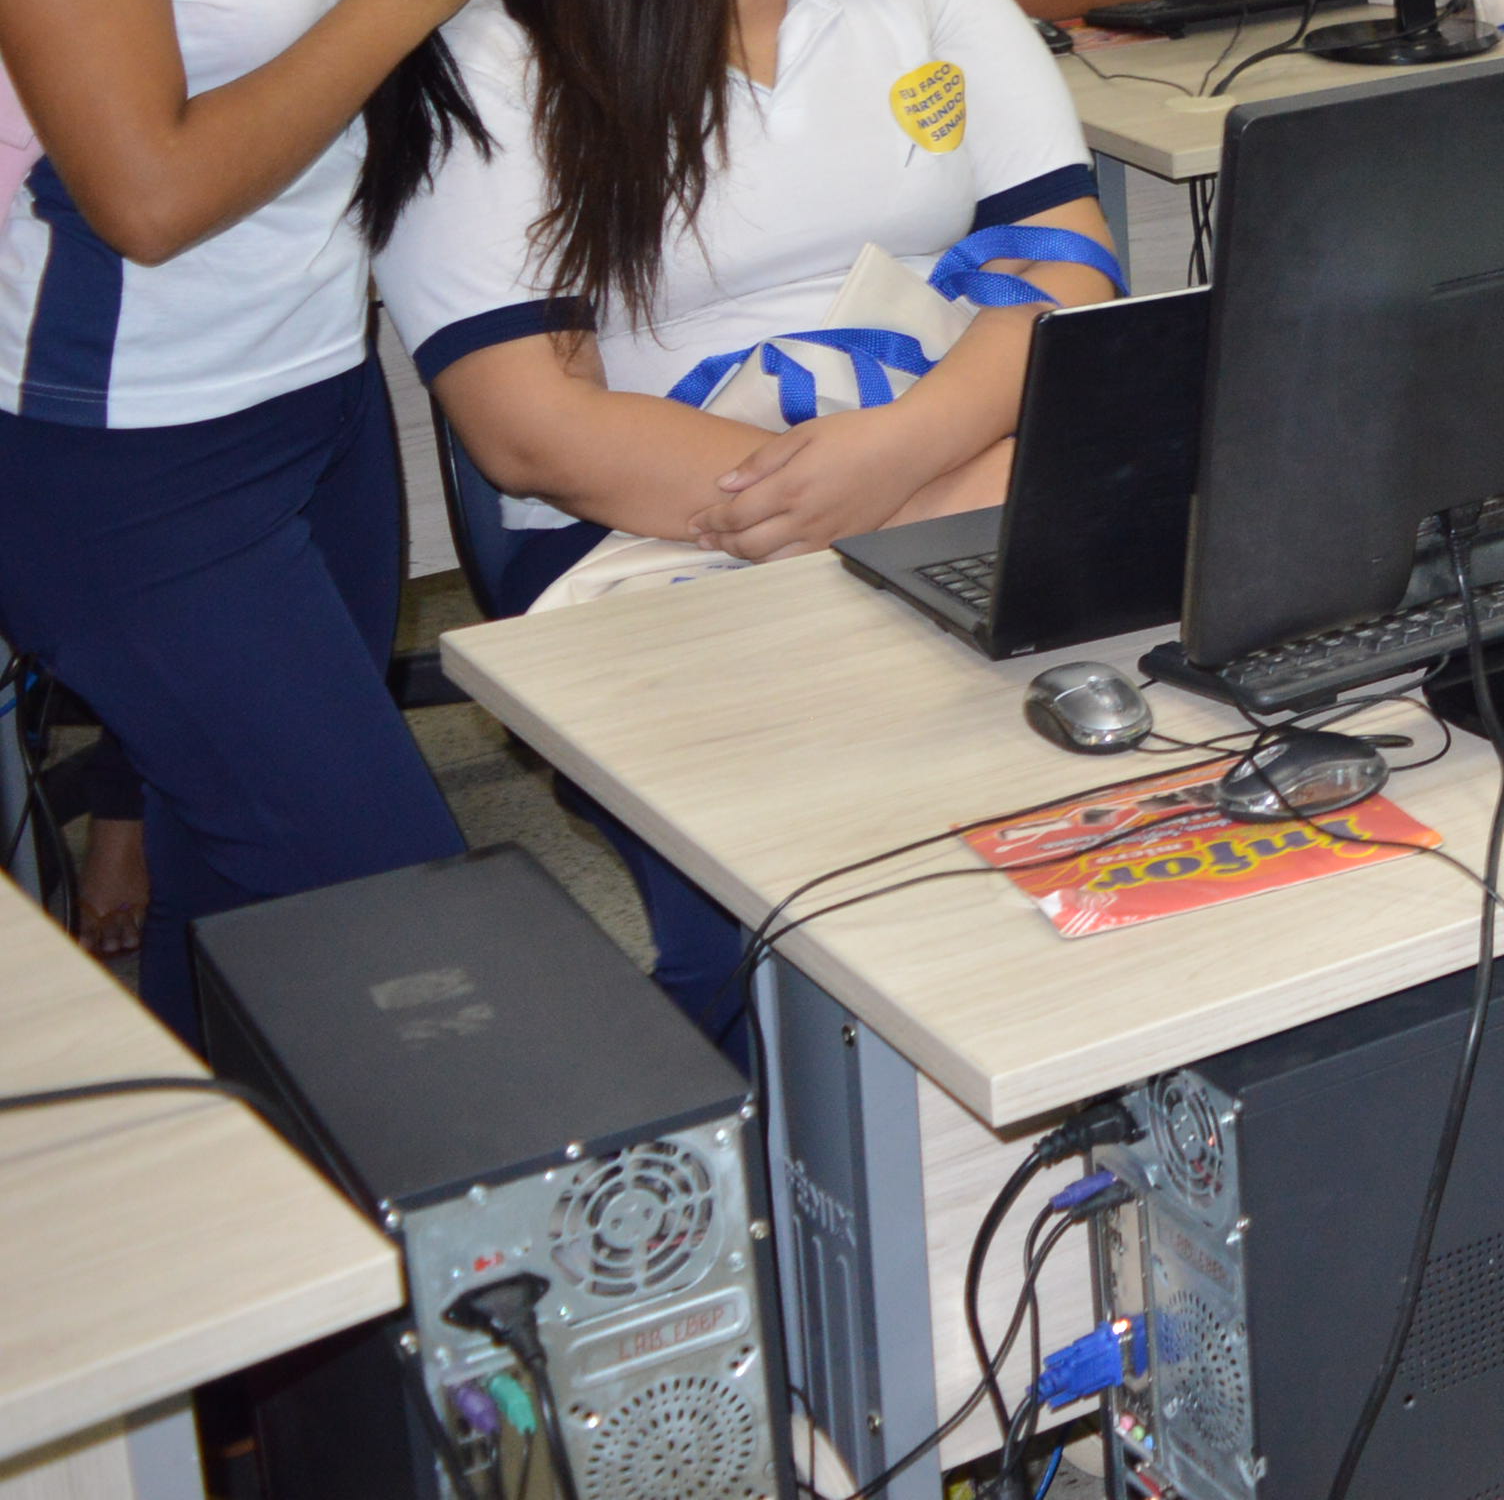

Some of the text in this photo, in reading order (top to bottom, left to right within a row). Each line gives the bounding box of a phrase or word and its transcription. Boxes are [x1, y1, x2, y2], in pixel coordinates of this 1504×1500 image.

[899, 88, 917, 100] EU
[904, 74, 961, 116] PARTE DO
[917, 92, 964, 129] MUNDO
